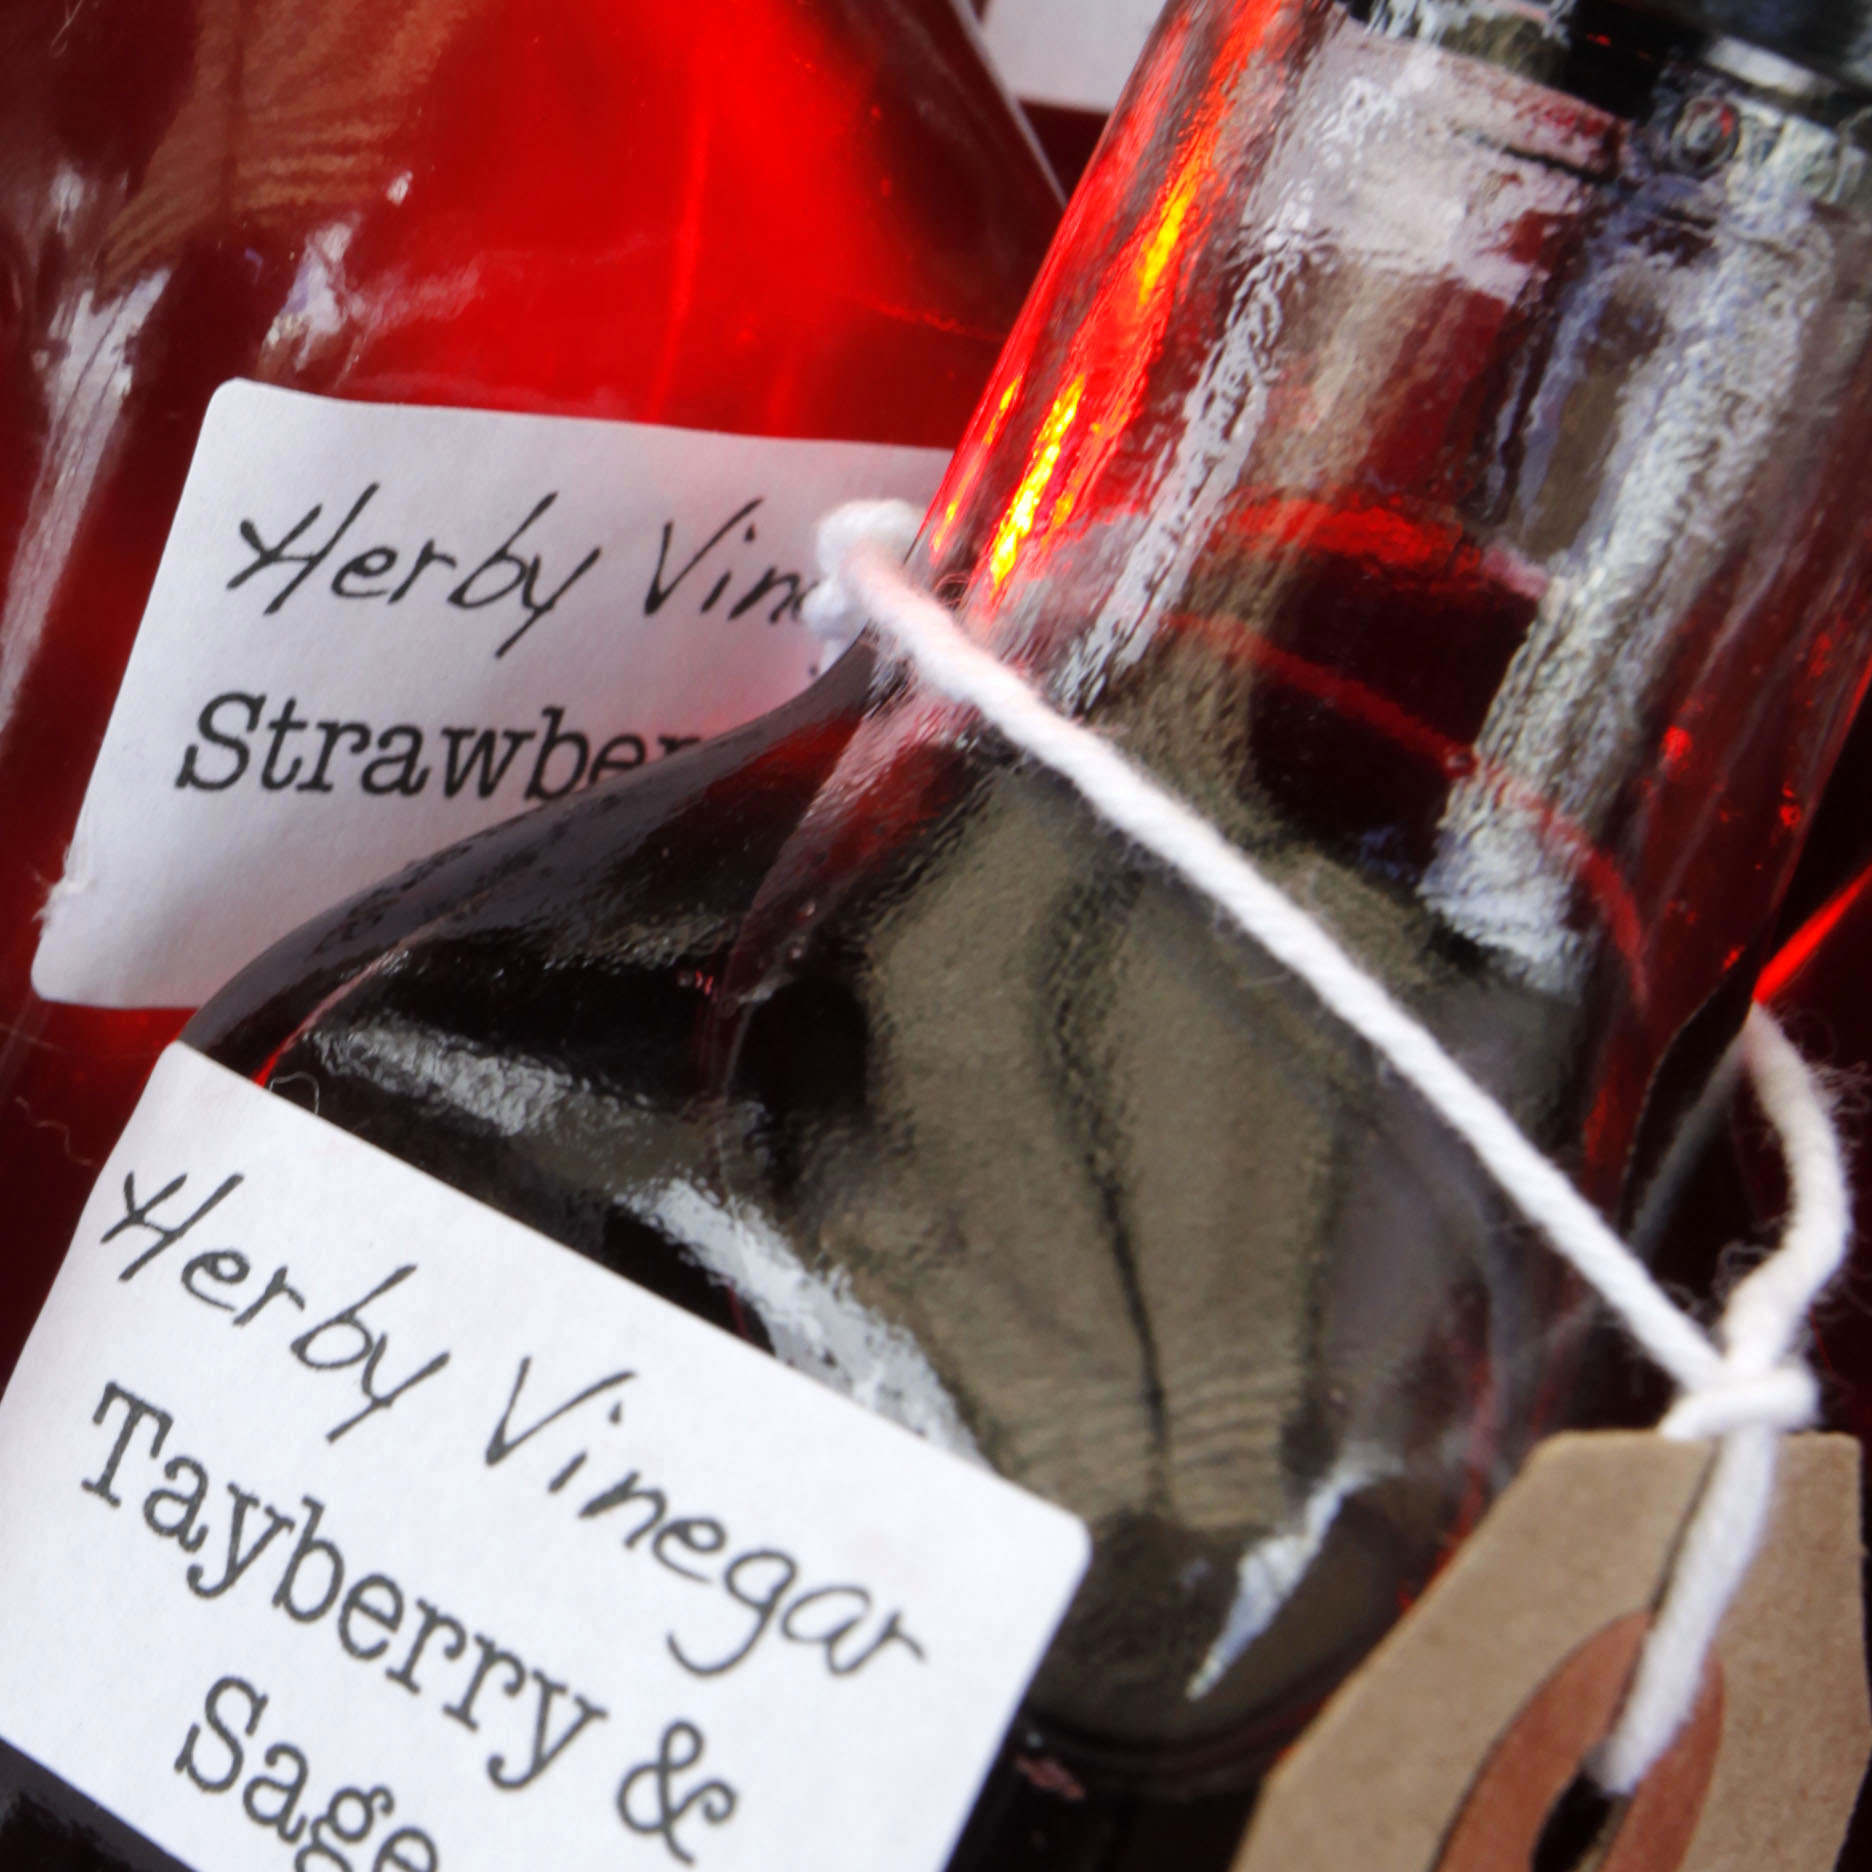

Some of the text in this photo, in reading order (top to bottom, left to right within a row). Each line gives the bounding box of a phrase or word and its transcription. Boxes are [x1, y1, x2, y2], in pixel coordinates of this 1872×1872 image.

[225, 481, 821, 660] Herby Vin
[79, 1379, 740, 1868] Tayberry &
[98, 1170, 926, 1680] Herby Vinegar
